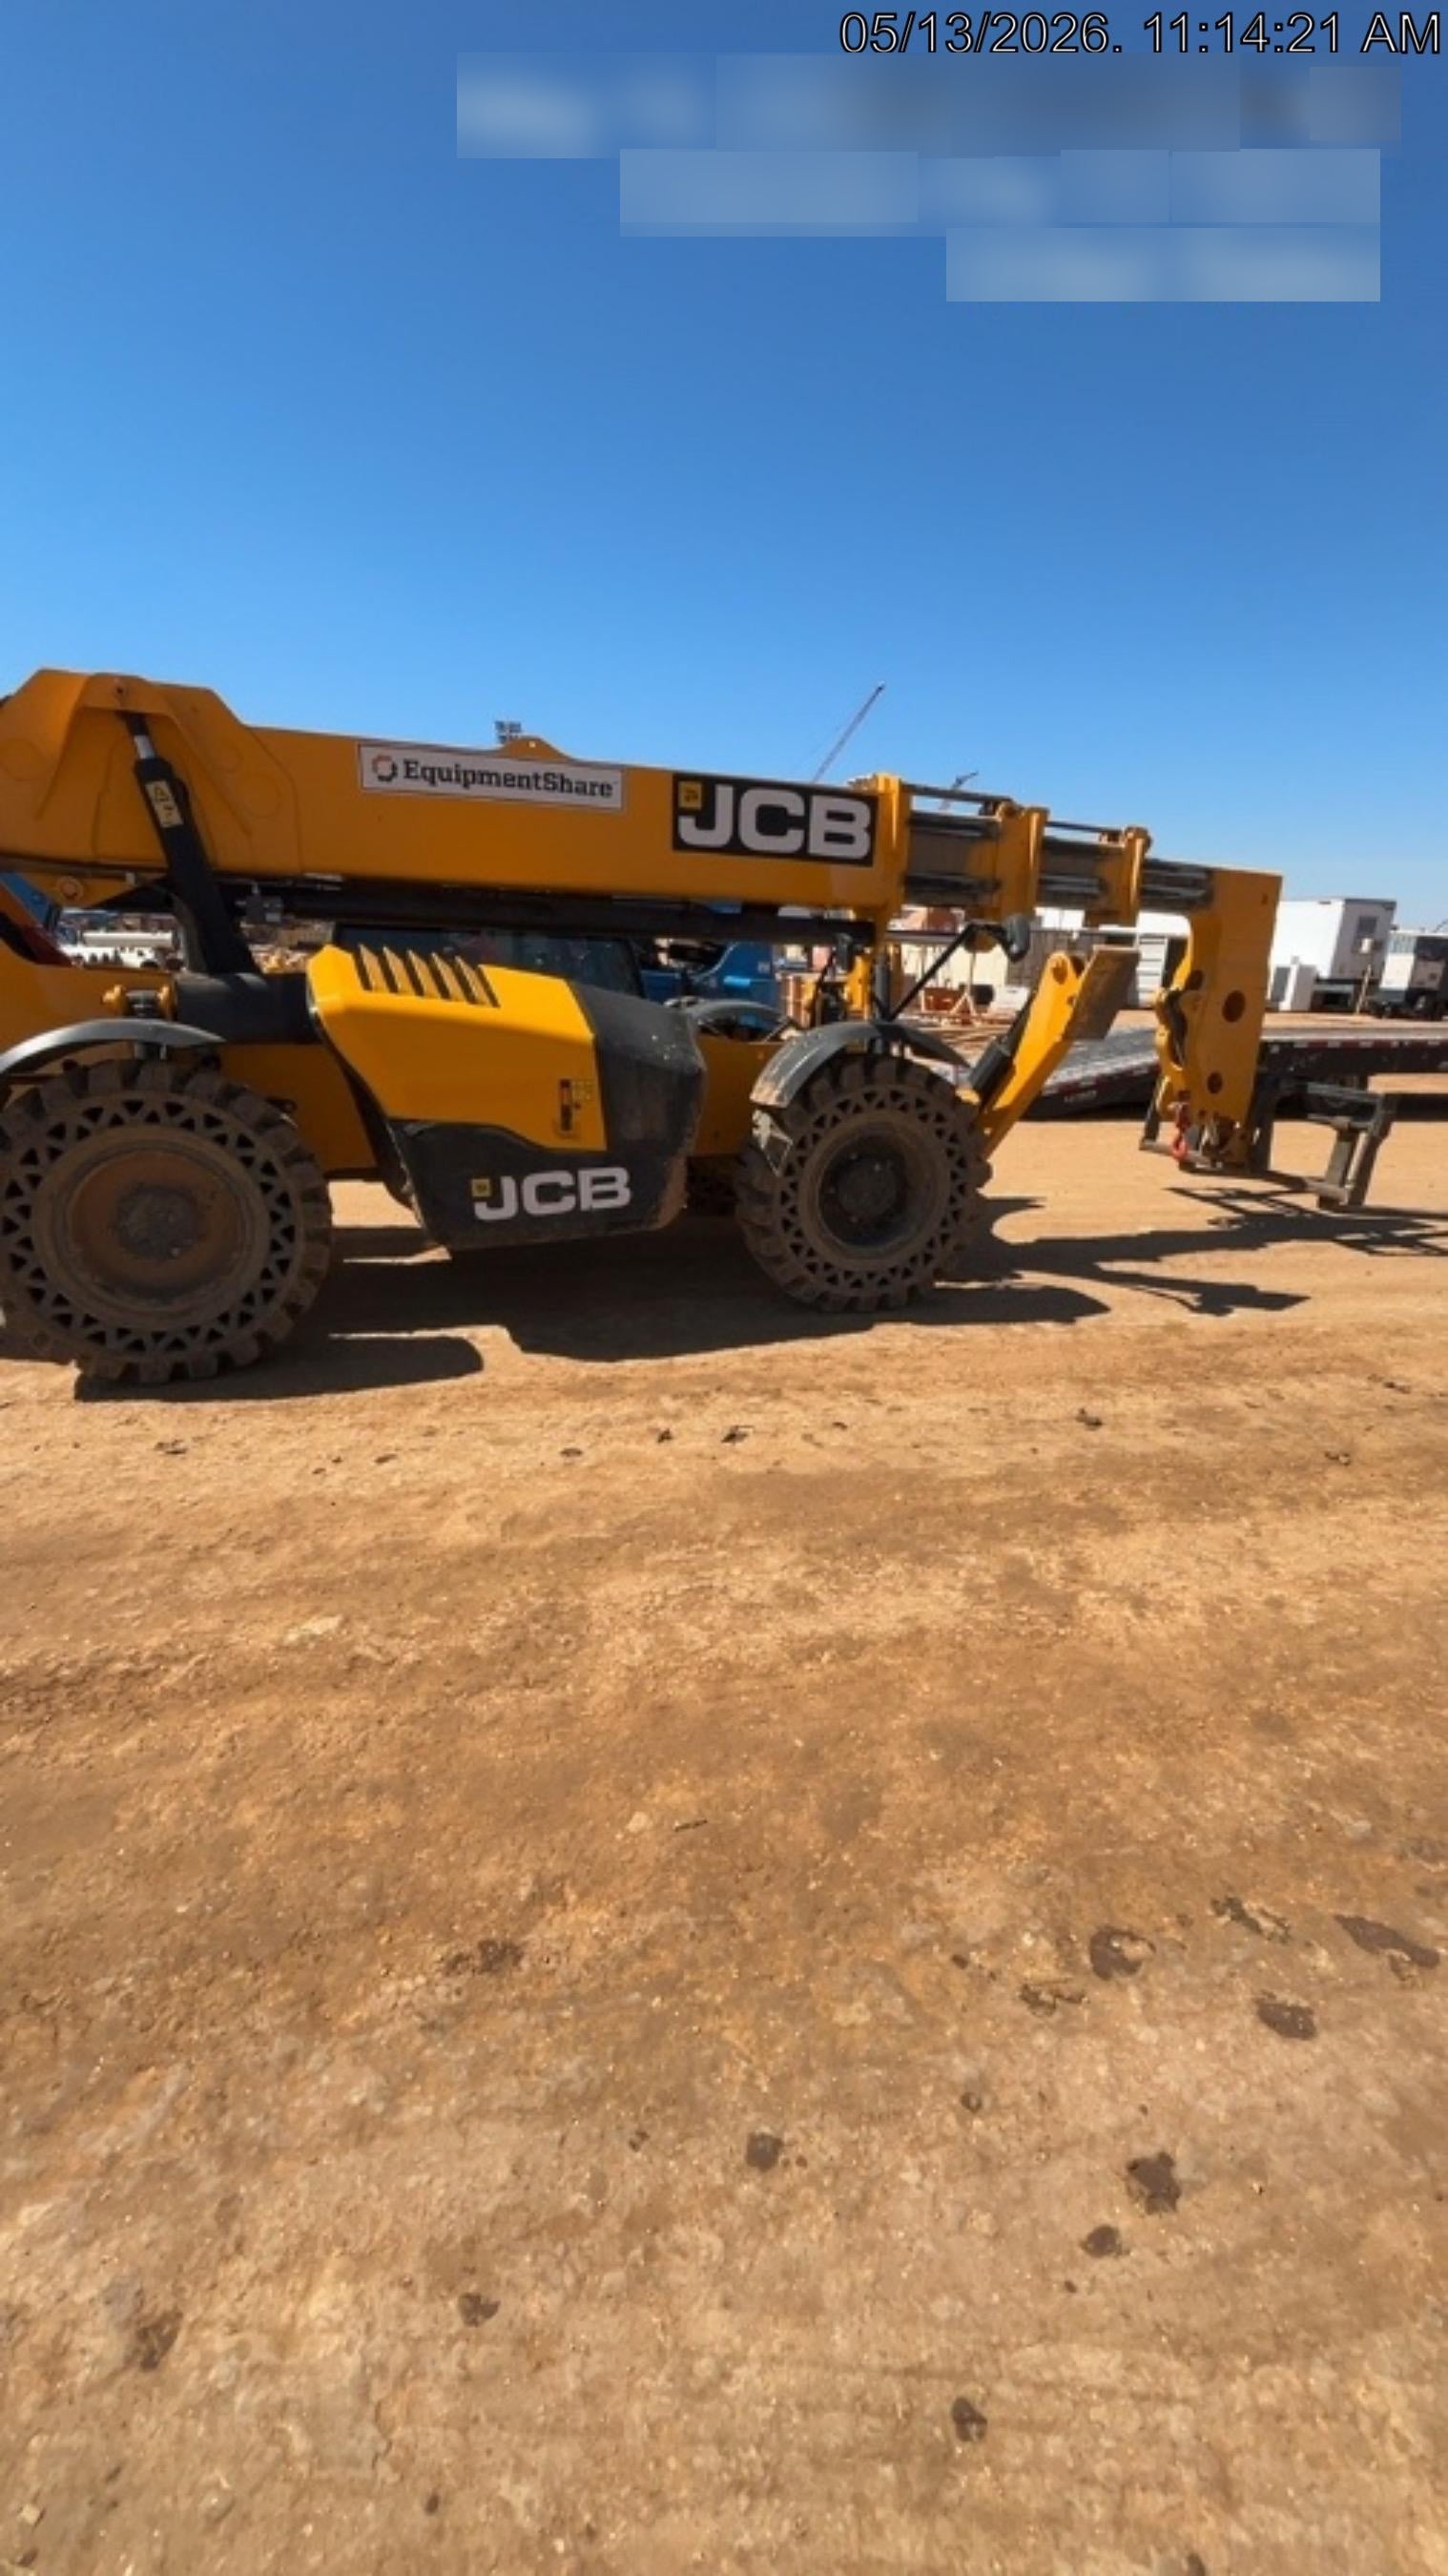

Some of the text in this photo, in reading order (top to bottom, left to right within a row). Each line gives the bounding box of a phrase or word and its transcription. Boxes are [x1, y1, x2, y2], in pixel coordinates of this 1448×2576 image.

[403, 758, 613, 798] EquipmentShare
[677, 783, 872, 860] JCB
[473, 1167, 631, 1221] JCB
